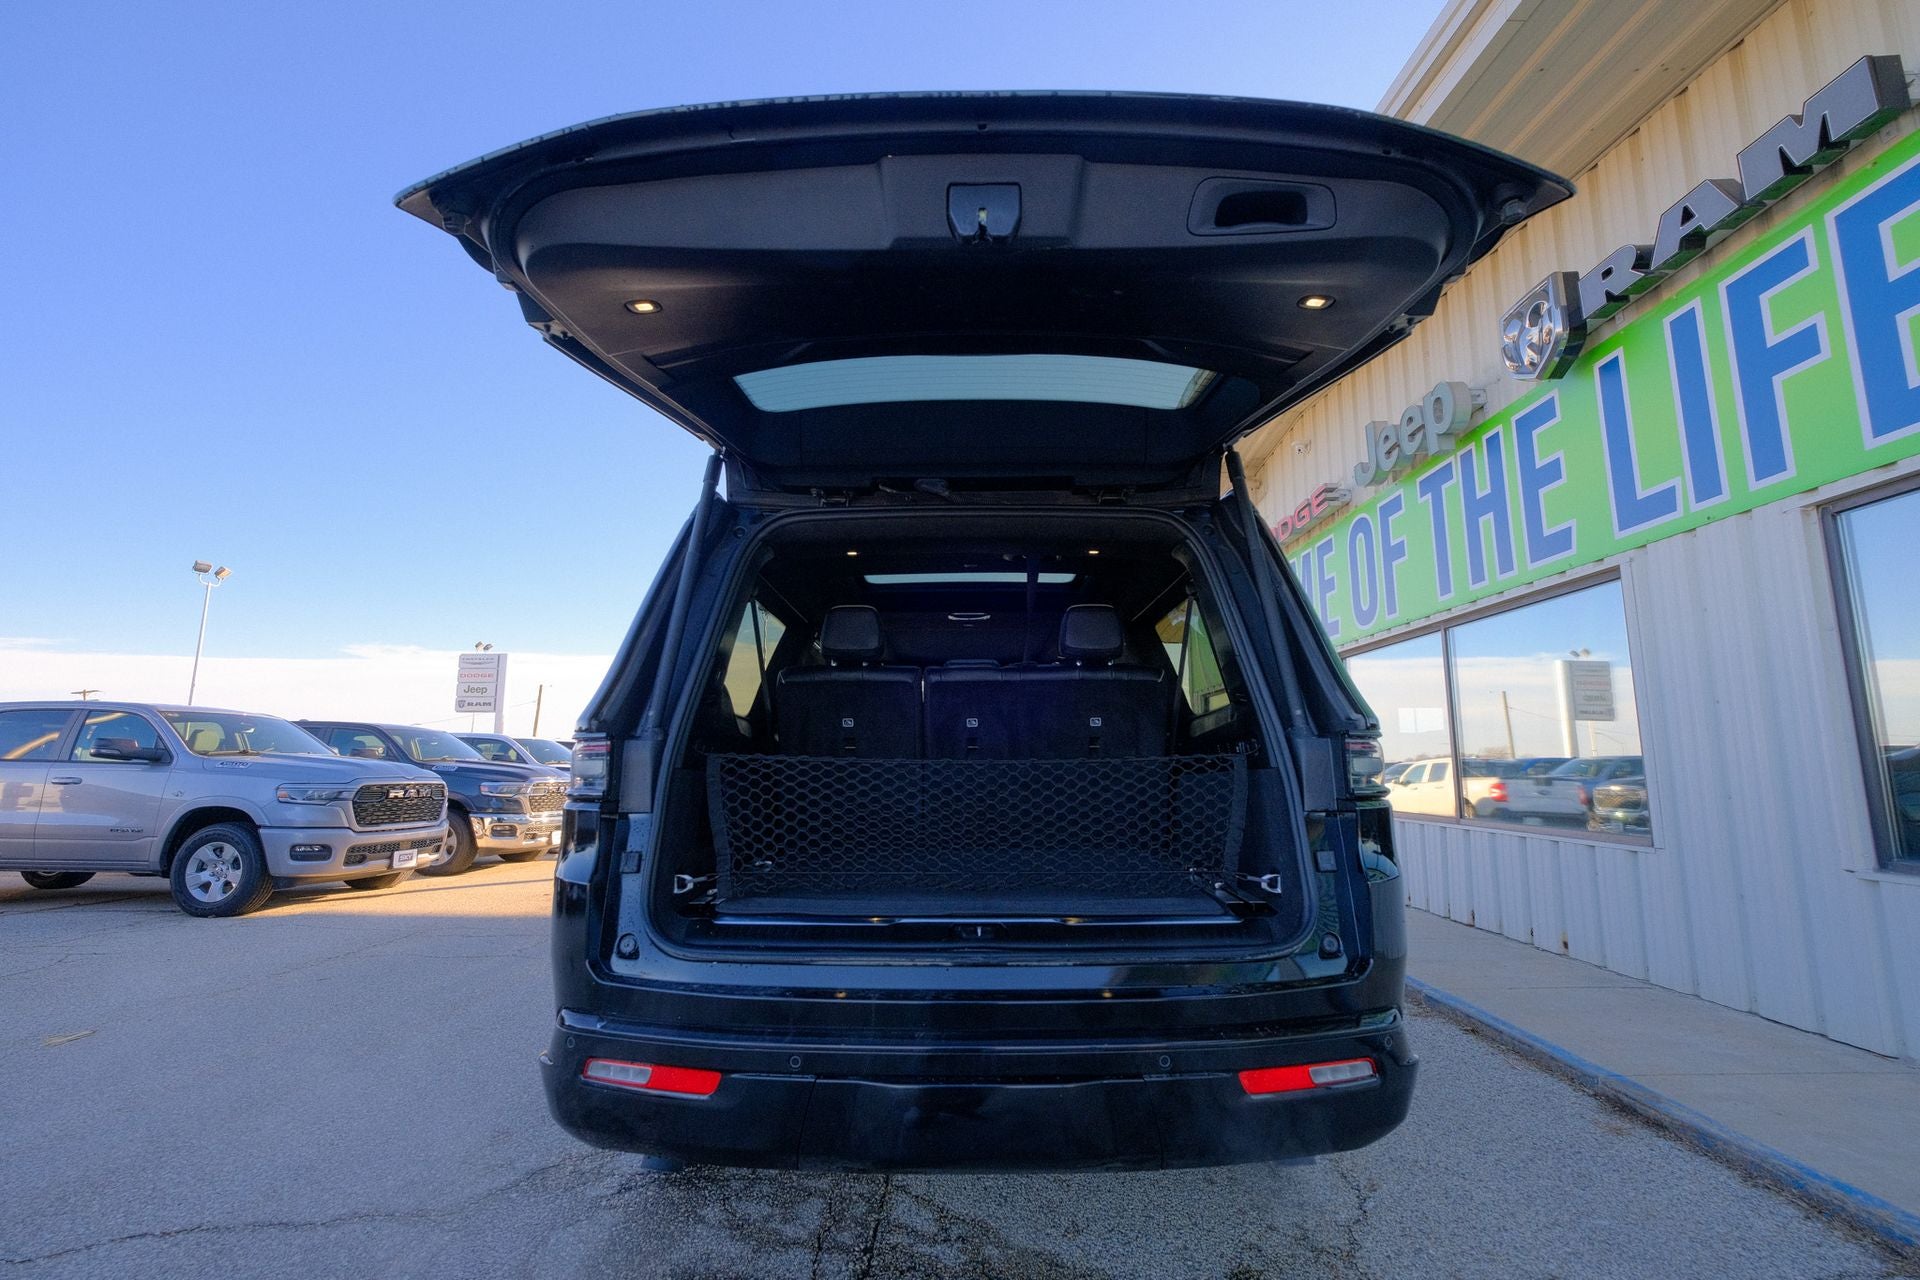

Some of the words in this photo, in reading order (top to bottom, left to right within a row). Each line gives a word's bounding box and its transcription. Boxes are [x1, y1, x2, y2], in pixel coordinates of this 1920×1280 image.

[1578, 55, 1885, 320] RAM
[1347, 488, 1408, 630] OF
[1416, 388, 1577, 601] THE
[1593, 153, 1920, 541] LIFE
[1354, 380, 1460, 487] Jeep
[1271, 485, 1329, 541] DGE
[463, 685, 488, 695] Jeep
[388, 788, 433, 799] RAM
